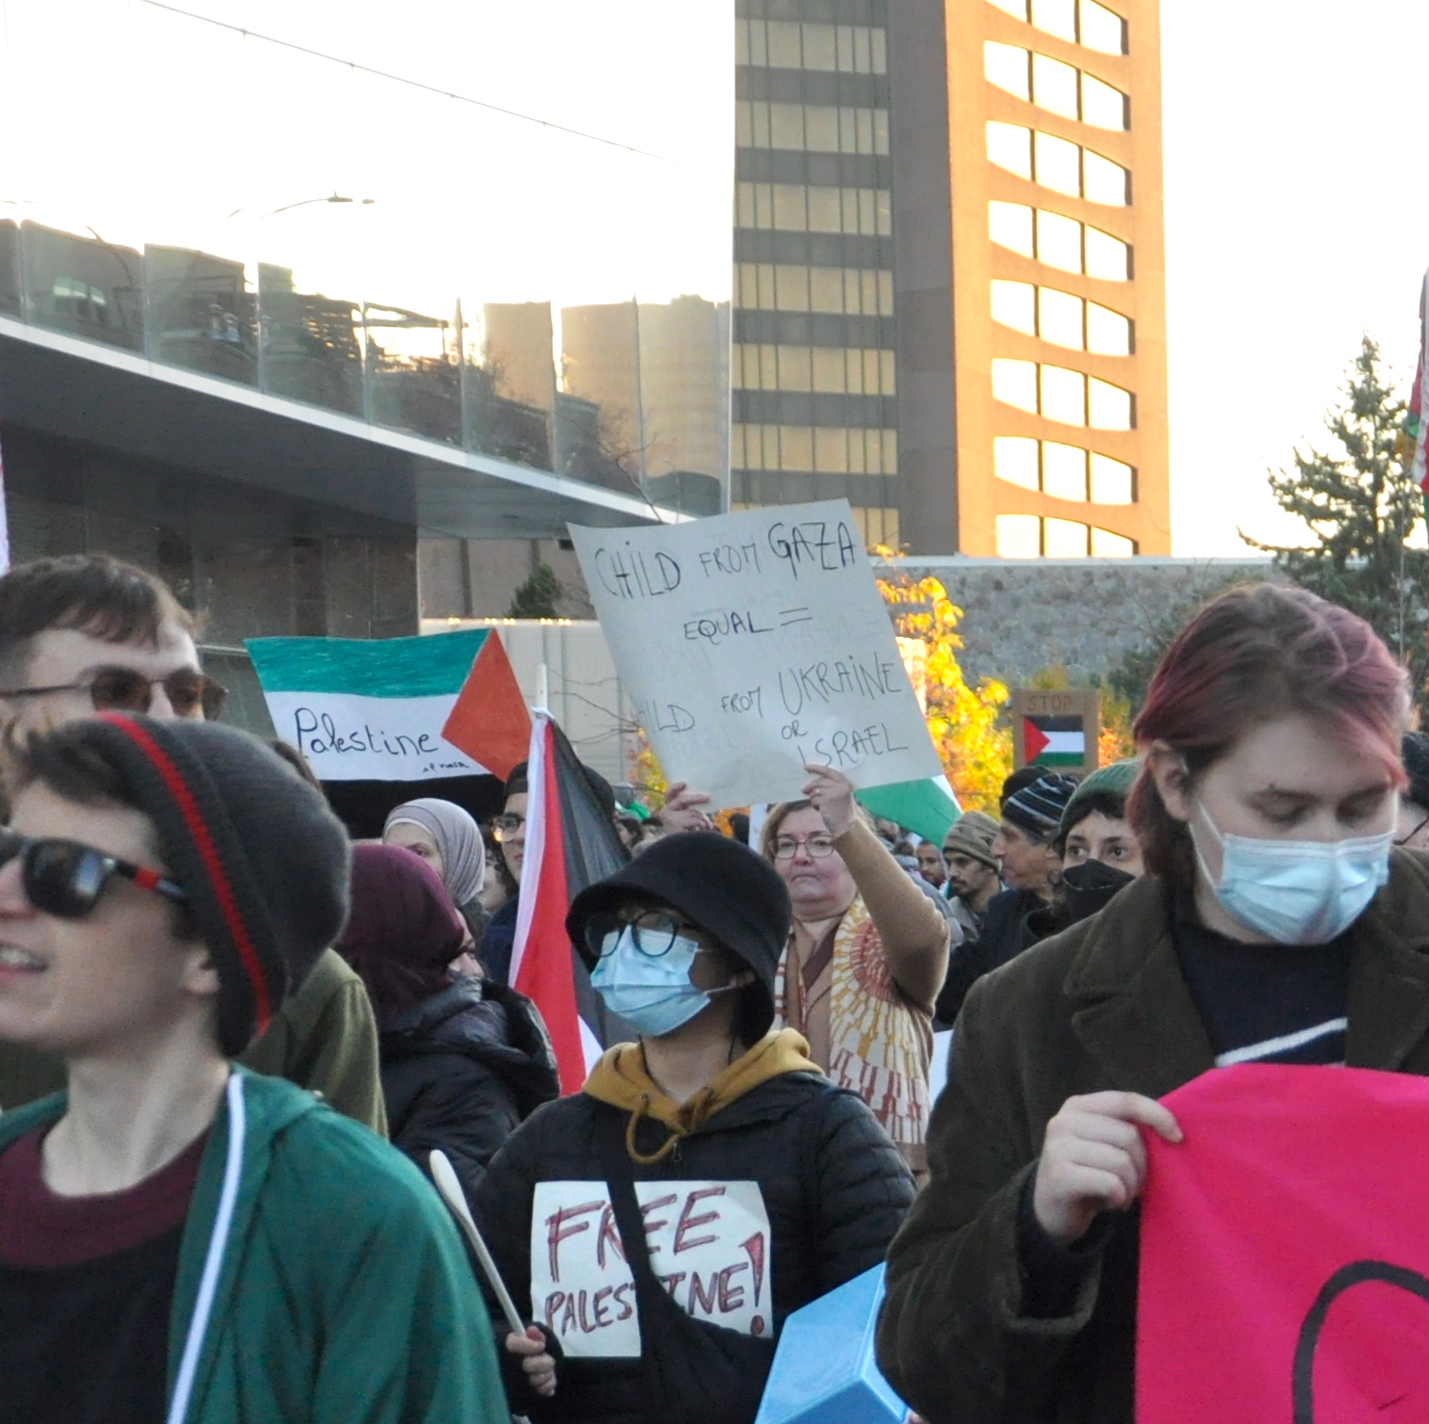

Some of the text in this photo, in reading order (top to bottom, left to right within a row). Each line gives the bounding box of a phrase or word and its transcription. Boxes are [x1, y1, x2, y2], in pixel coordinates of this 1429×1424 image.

[594, 521, 856, 600] CHILD FROM GAZA
[684, 610, 775, 646] EQUAL
[720, 686, 764, 719] FROM
[778, 651, 902, 716] UKRAINE
[1027, 694, 1072, 712] STOP
[294, 706, 439, 760] Palestine
[780, 719, 808, 740] OR
[796, 722, 909, 768] ISRAEL
